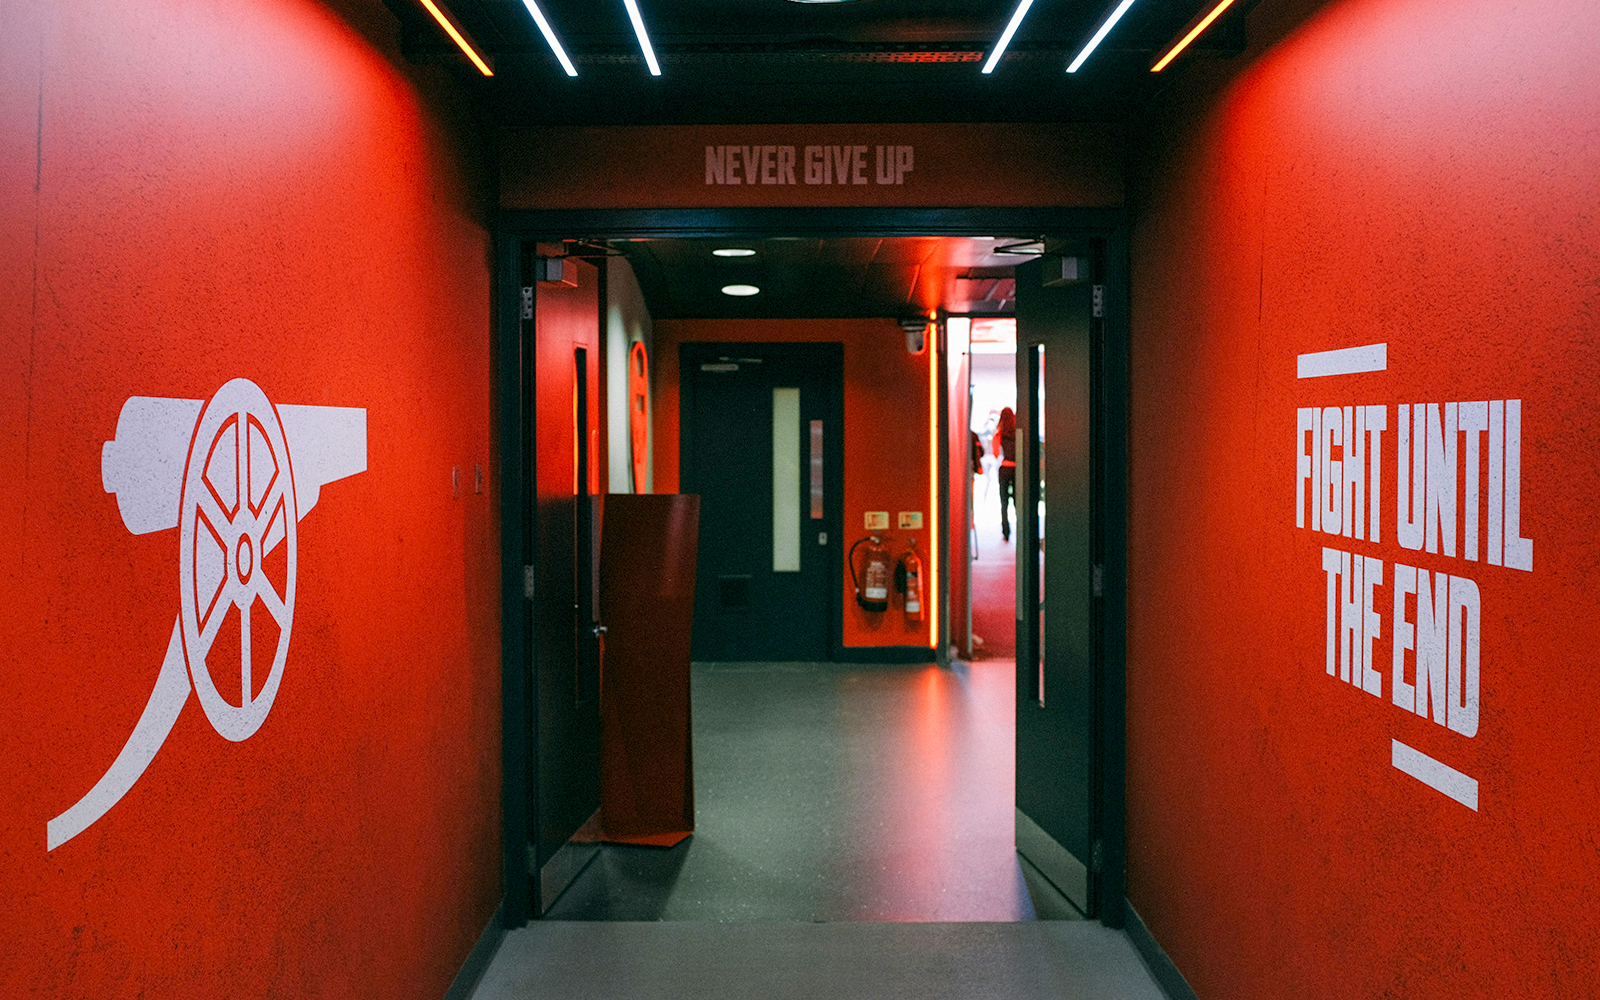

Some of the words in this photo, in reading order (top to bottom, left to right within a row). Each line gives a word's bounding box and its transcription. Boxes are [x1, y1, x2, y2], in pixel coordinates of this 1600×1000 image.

[705, 145, 796, 185] NEVER
[804, 145, 868, 185] GIVE
[876, 145, 914, 185] UP
[1296, 404, 1387, 544] FIGHT
[1397, 399, 1533, 572] UNTIL
[1322, 546, 1384, 699] THE
[1392, 563, 1481, 738] END
